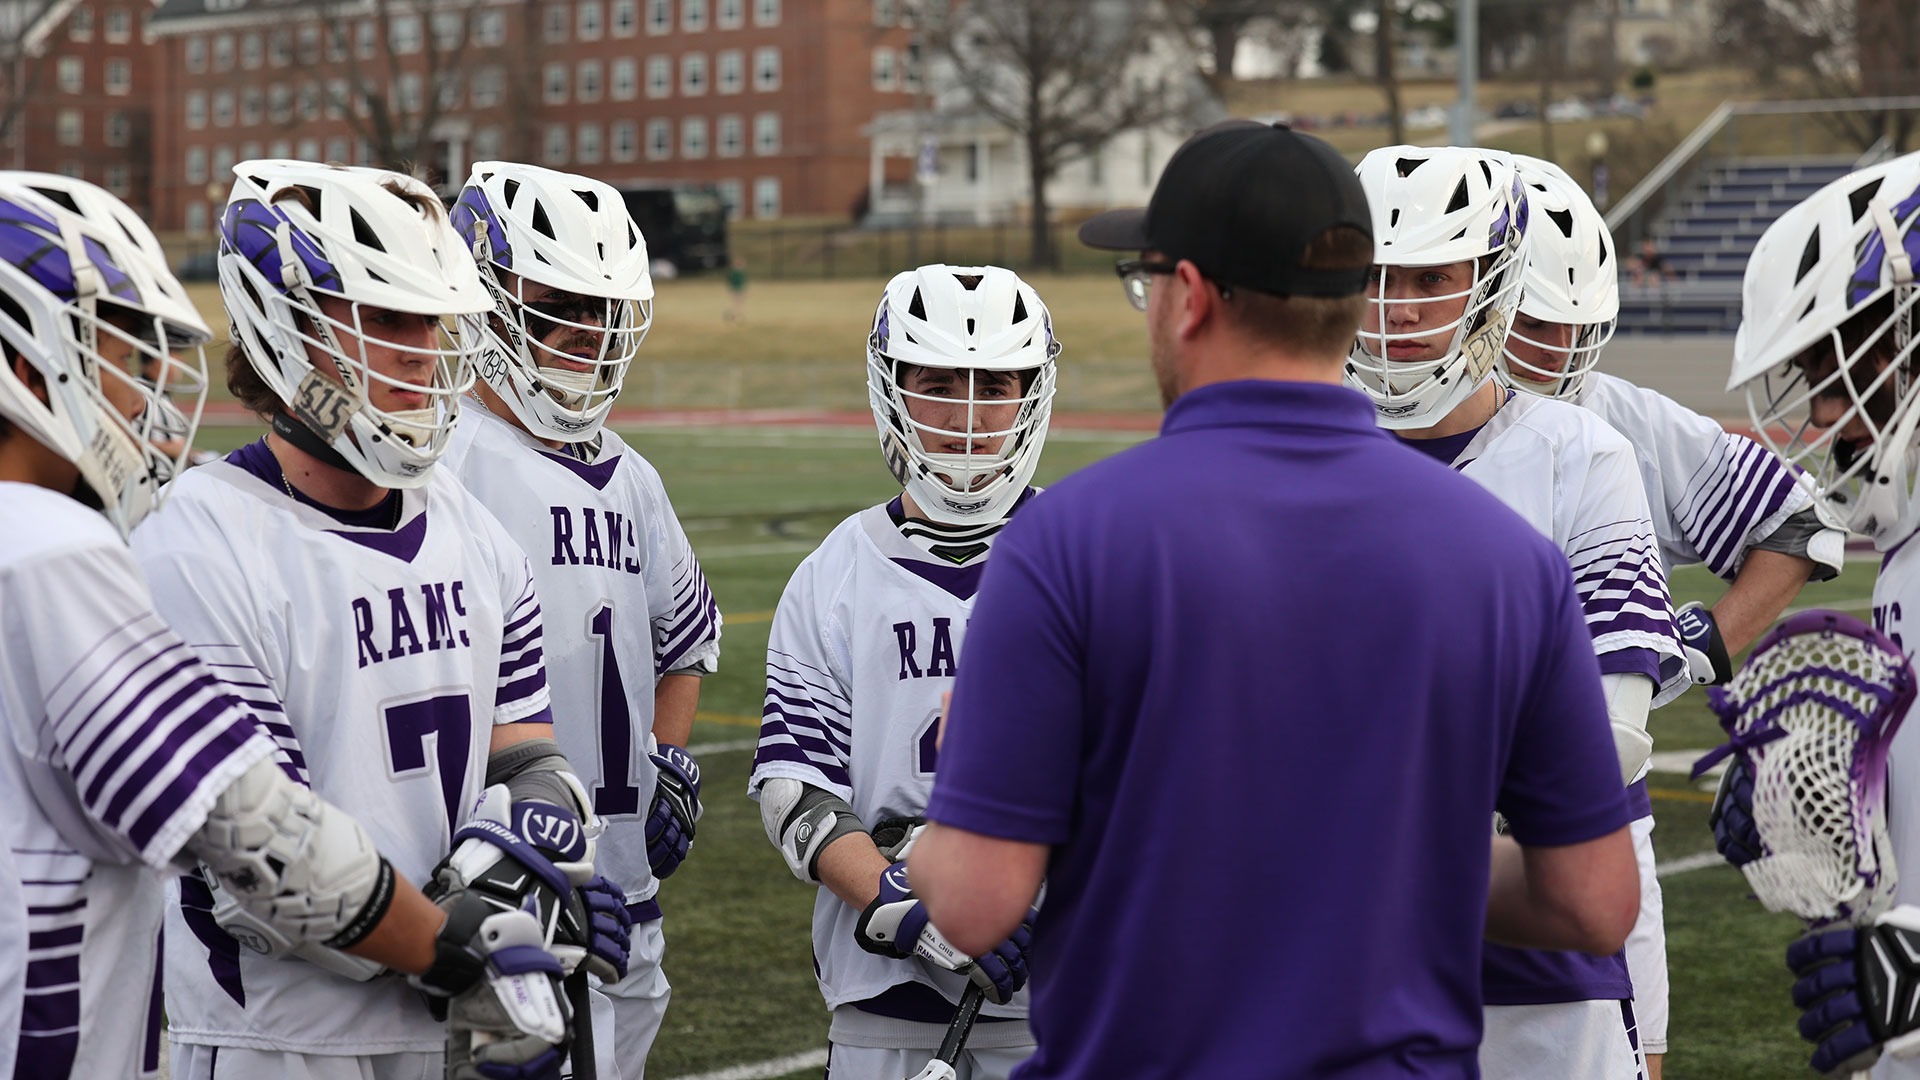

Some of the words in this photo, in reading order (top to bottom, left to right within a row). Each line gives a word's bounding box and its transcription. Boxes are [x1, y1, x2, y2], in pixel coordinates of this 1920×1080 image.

[299, 297, 355, 388] cscde
[550, 506, 641, 575] RAMS
[351, 580, 470, 669] RAMS
[893, 617, 970, 681] RA
[592, 606, 639, 815] 1
[384, 693, 472, 840] 7
